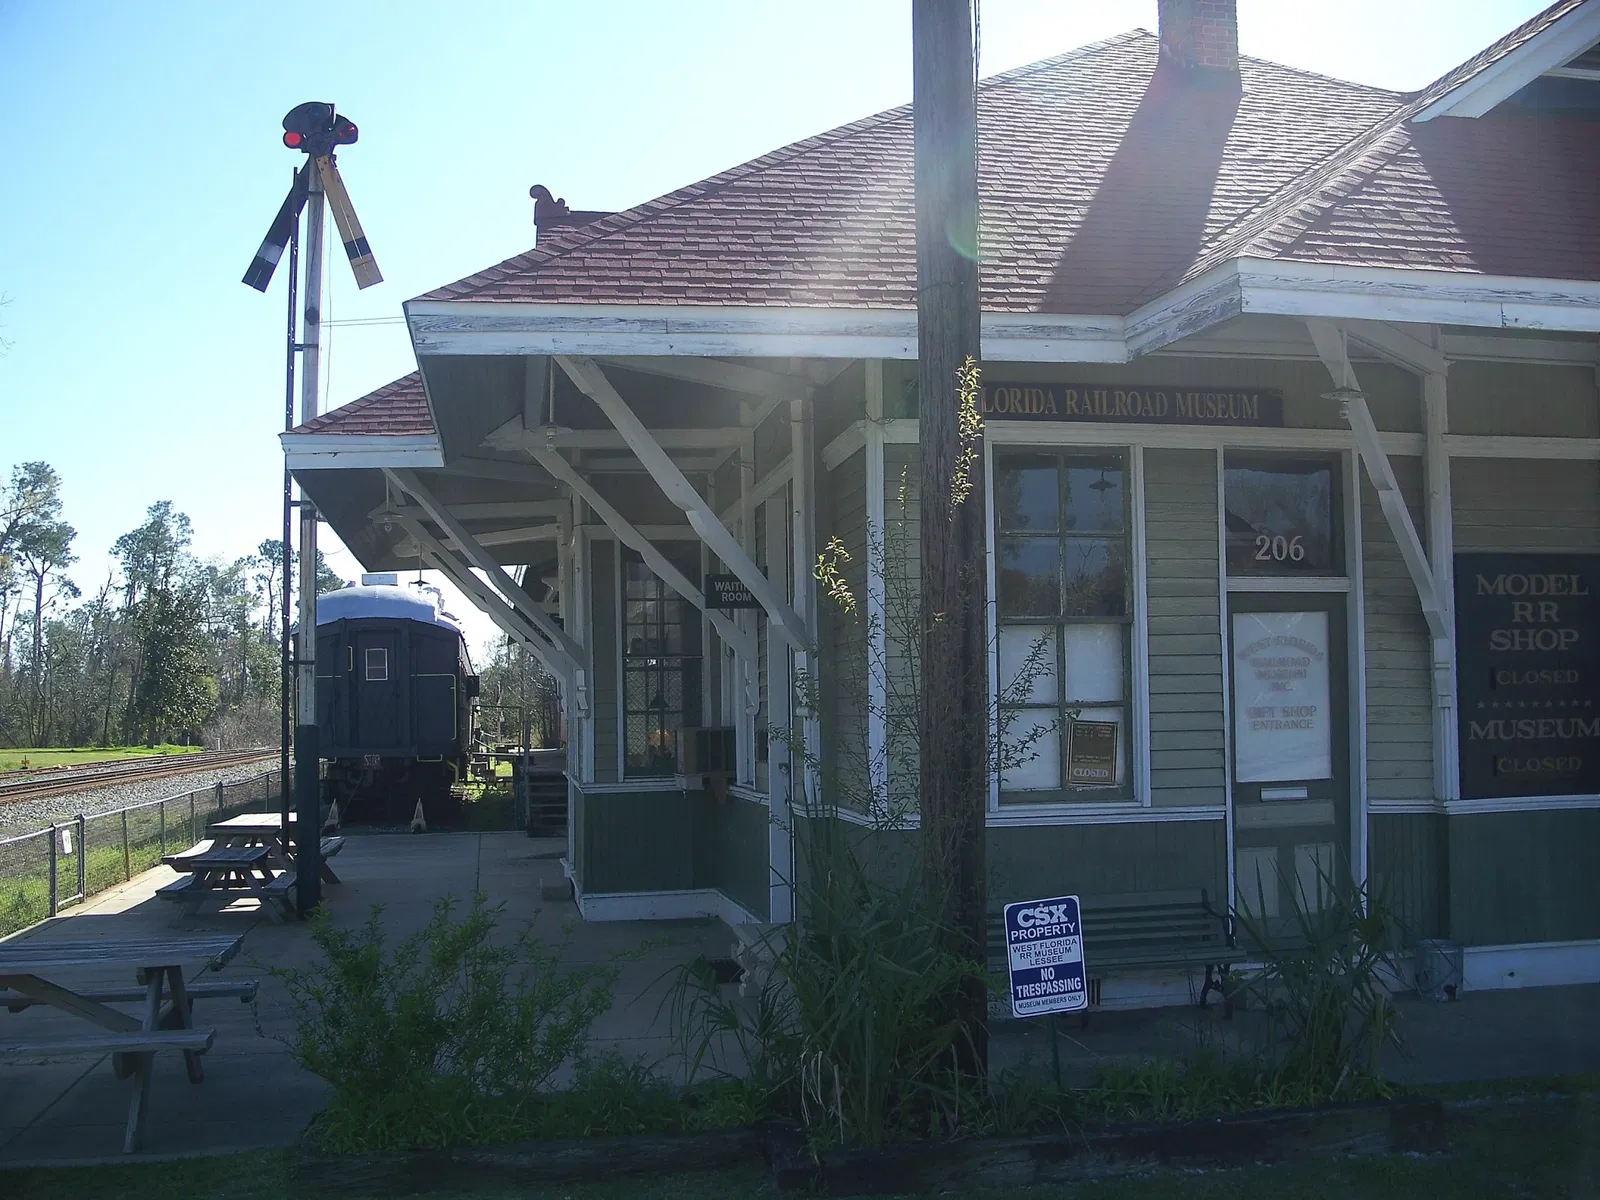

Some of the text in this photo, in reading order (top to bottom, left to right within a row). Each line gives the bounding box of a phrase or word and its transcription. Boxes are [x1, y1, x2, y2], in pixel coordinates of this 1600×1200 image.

[981, 387, 1260, 420] LORIDA RAILROAD MUSEUM
[1255, 535, 1305, 561] 206
[714, 581, 748, 591] WAITI
[1476, 573, 1589, 596] MODEL
[721, 592, 752, 602] ROOM
[1511, 601, 1560, 623] RR
[1490, 628, 1580, 651] SHOP
[1495, 669, 1580, 686] CLOSED
[1282, 705, 1317, 718] SHOP
[1252, 719, 1314, 731] ENTRANCE
[1468, 718, 1600, 740] MUSEUM
[1073, 768, 1108, 777] CLOSED
[1497, 756, 1582, 773] CLOSED
[1017, 903, 1068, 927] CSX
[1011, 922, 1076, 941] PROPERTY
[1012, 938, 1078, 954] WEST FLORIDA
[1020, 946, 1072, 960] RR MUSEUM
[1029, 955, 1063, 966] LESSEE
[1040, 967, 1055, 981] NO
[1016, 977, 1082, 998] TRESPASSING
[1018, 994, 1082, 1009] MUSEUM MEMBERS ONLY
